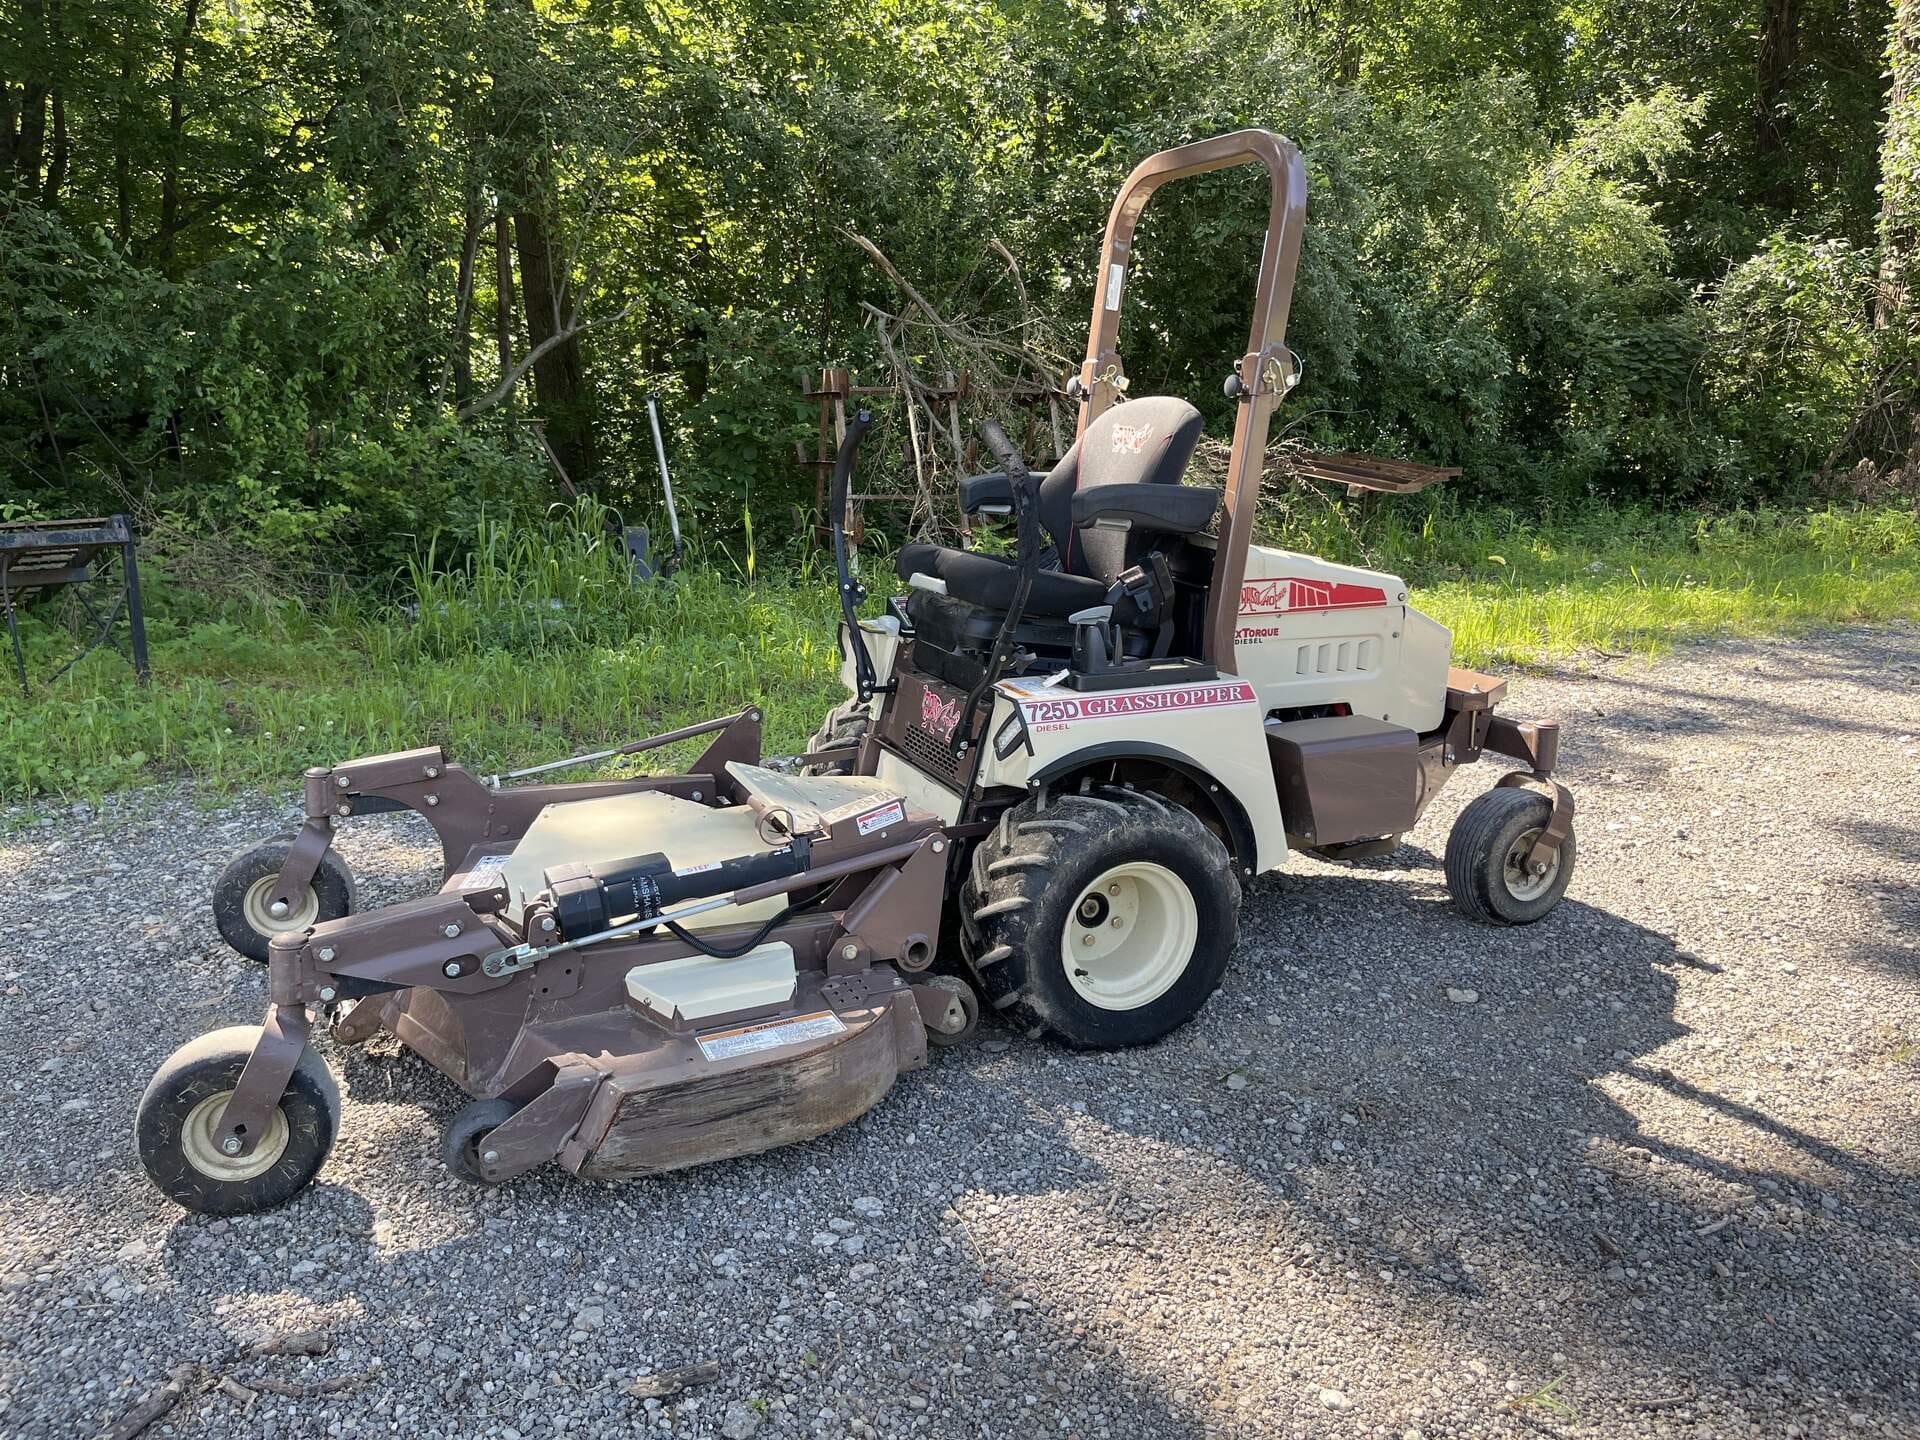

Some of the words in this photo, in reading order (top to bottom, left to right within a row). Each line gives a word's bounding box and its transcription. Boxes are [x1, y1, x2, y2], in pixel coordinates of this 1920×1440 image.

[1234, 627, 1280, 639] XTORQUE
[1234, 637, 1264, 645] DIESEL
[1025, 700, 1079, 722] 725D
[1086, 685, 1243, 716] GRASSHOPPER
[1036, 723, 1071, 733] DIESEL
